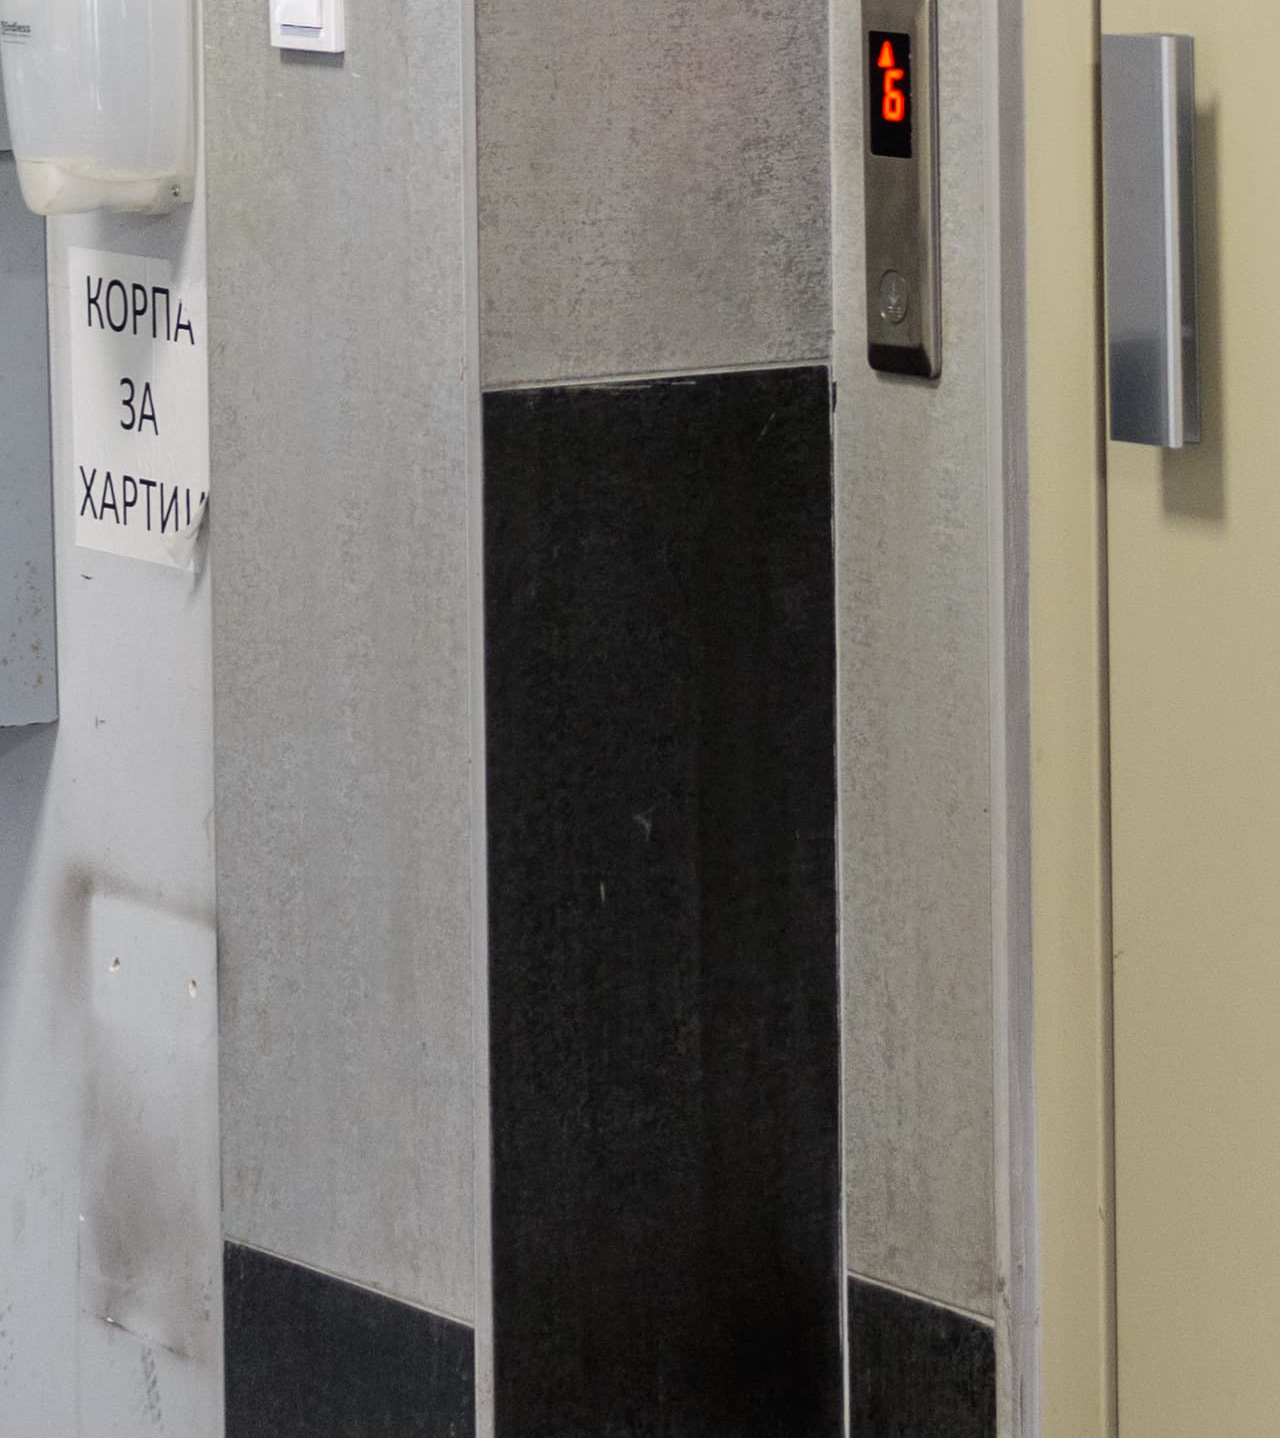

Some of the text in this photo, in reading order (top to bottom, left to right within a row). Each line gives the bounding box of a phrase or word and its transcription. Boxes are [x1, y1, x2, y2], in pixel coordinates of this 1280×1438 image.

[881, 67, 906, 123] 6
[86, 275, 195, 345] КОРПА
[119, 377, 159, 436] ЗА
